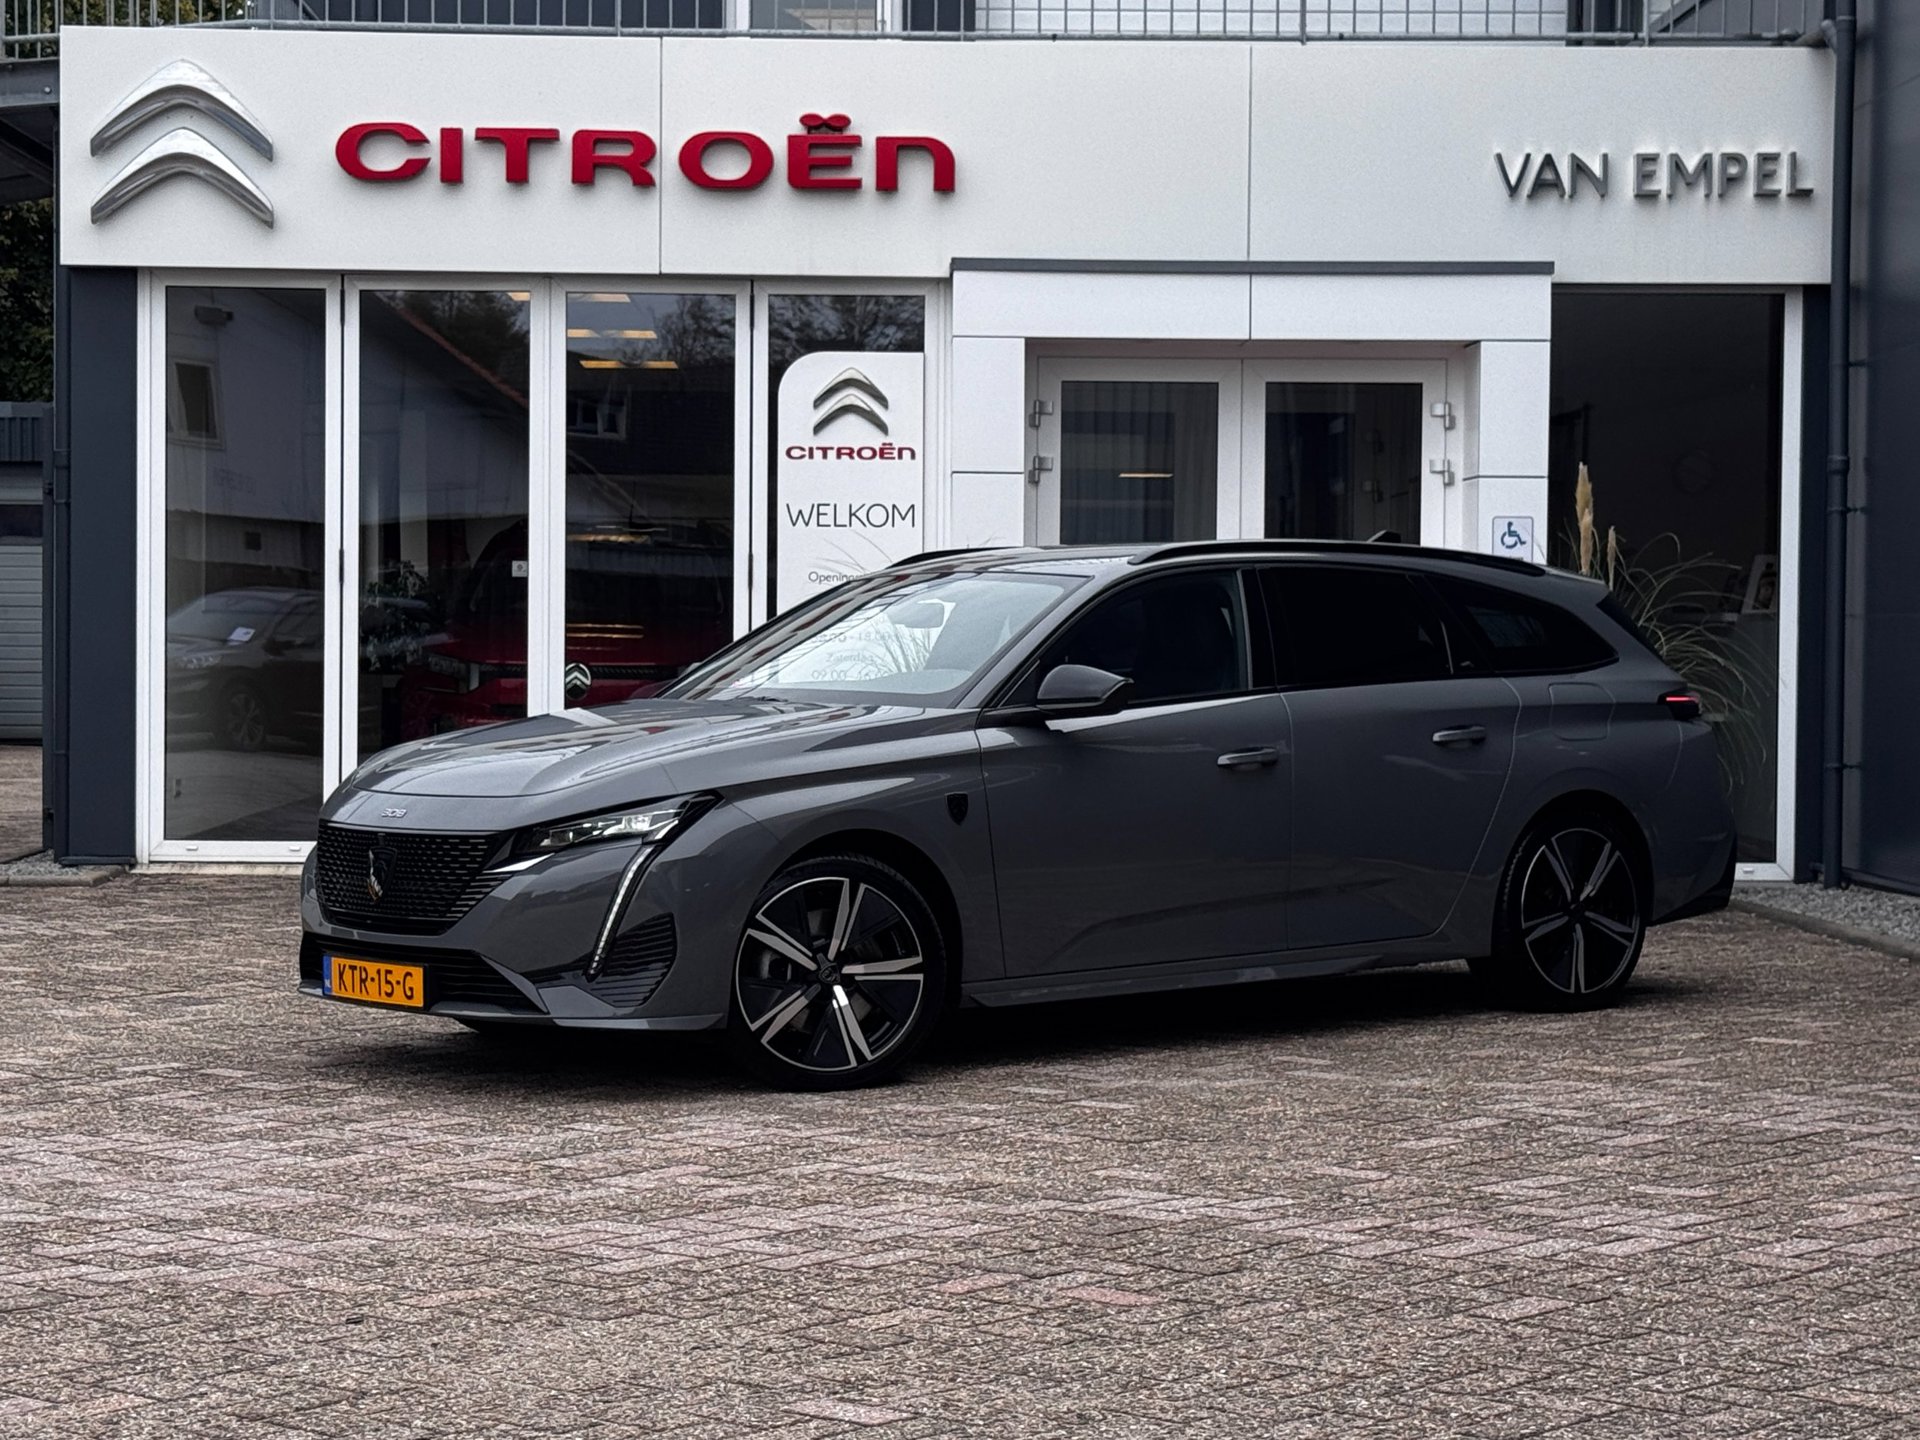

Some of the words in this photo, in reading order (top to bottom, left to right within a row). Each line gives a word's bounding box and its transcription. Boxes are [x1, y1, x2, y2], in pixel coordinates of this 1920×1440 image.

[1494, 152, 1609, 199] VAN
[1633, 152, 1814, 199] EMPEL
[786, 503, 915, 528] WELKOM
[337, 963, 415, 1001] KTR-15-G
